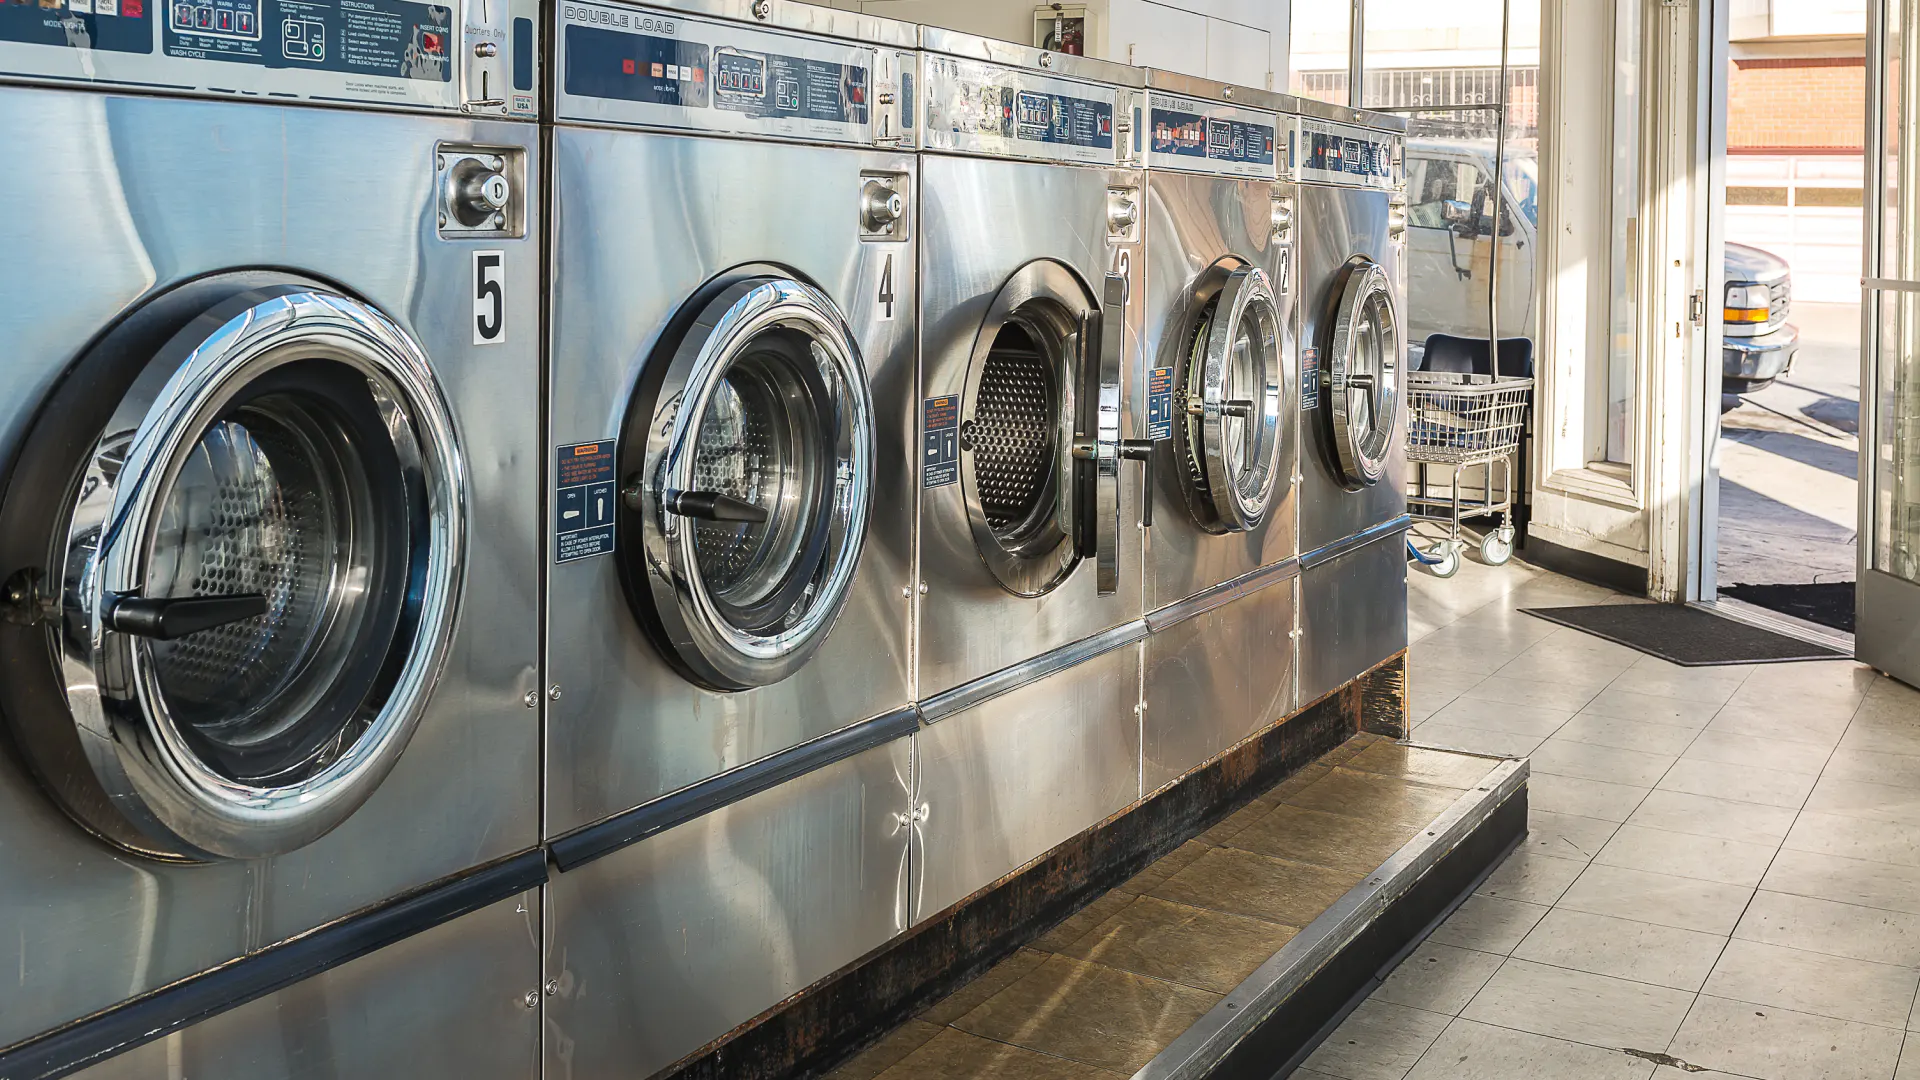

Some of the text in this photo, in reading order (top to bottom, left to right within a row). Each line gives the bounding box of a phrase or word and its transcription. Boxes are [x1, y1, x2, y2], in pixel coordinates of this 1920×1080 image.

[341, 1, 374, 10] INSTRUCTIONS
[565, 6, 674, 34] DOUBLE LOAD
[465, 25, 506, 41] Quarters Only
[879, 254, 894, 318] 4
[1282, 250, 1287, 293] 2
[477, 255, 502, 340] 5
